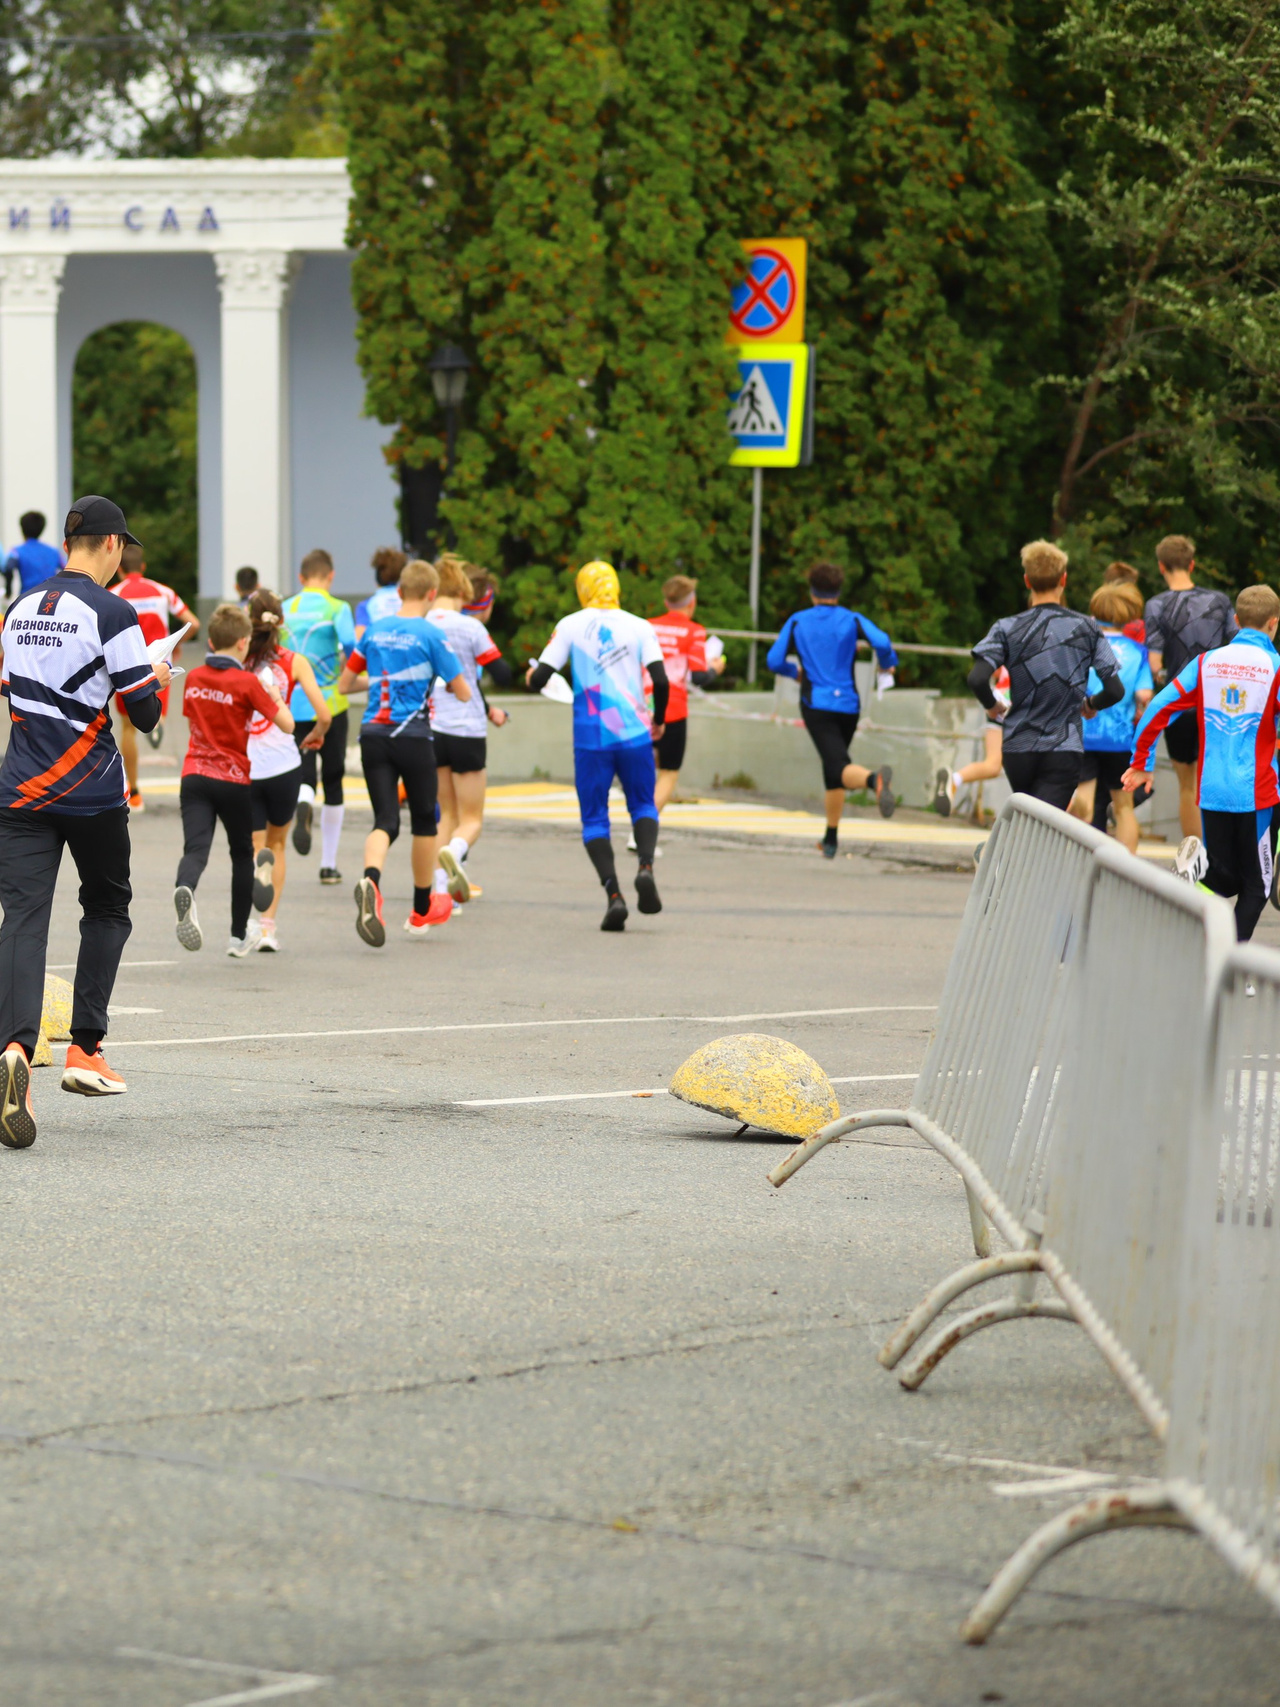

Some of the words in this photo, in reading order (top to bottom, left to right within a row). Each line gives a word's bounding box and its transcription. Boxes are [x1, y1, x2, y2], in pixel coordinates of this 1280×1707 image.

[123, 205, 220, 232] САД
[11, 618, 79, 634] Ивановская
[17, 631, 63, 648] область
[1207, 662, 1270, 676] УЛЬЯНОВСКАЯ
[1216, 668, 1257, 679] ОБЛАСТЬ
